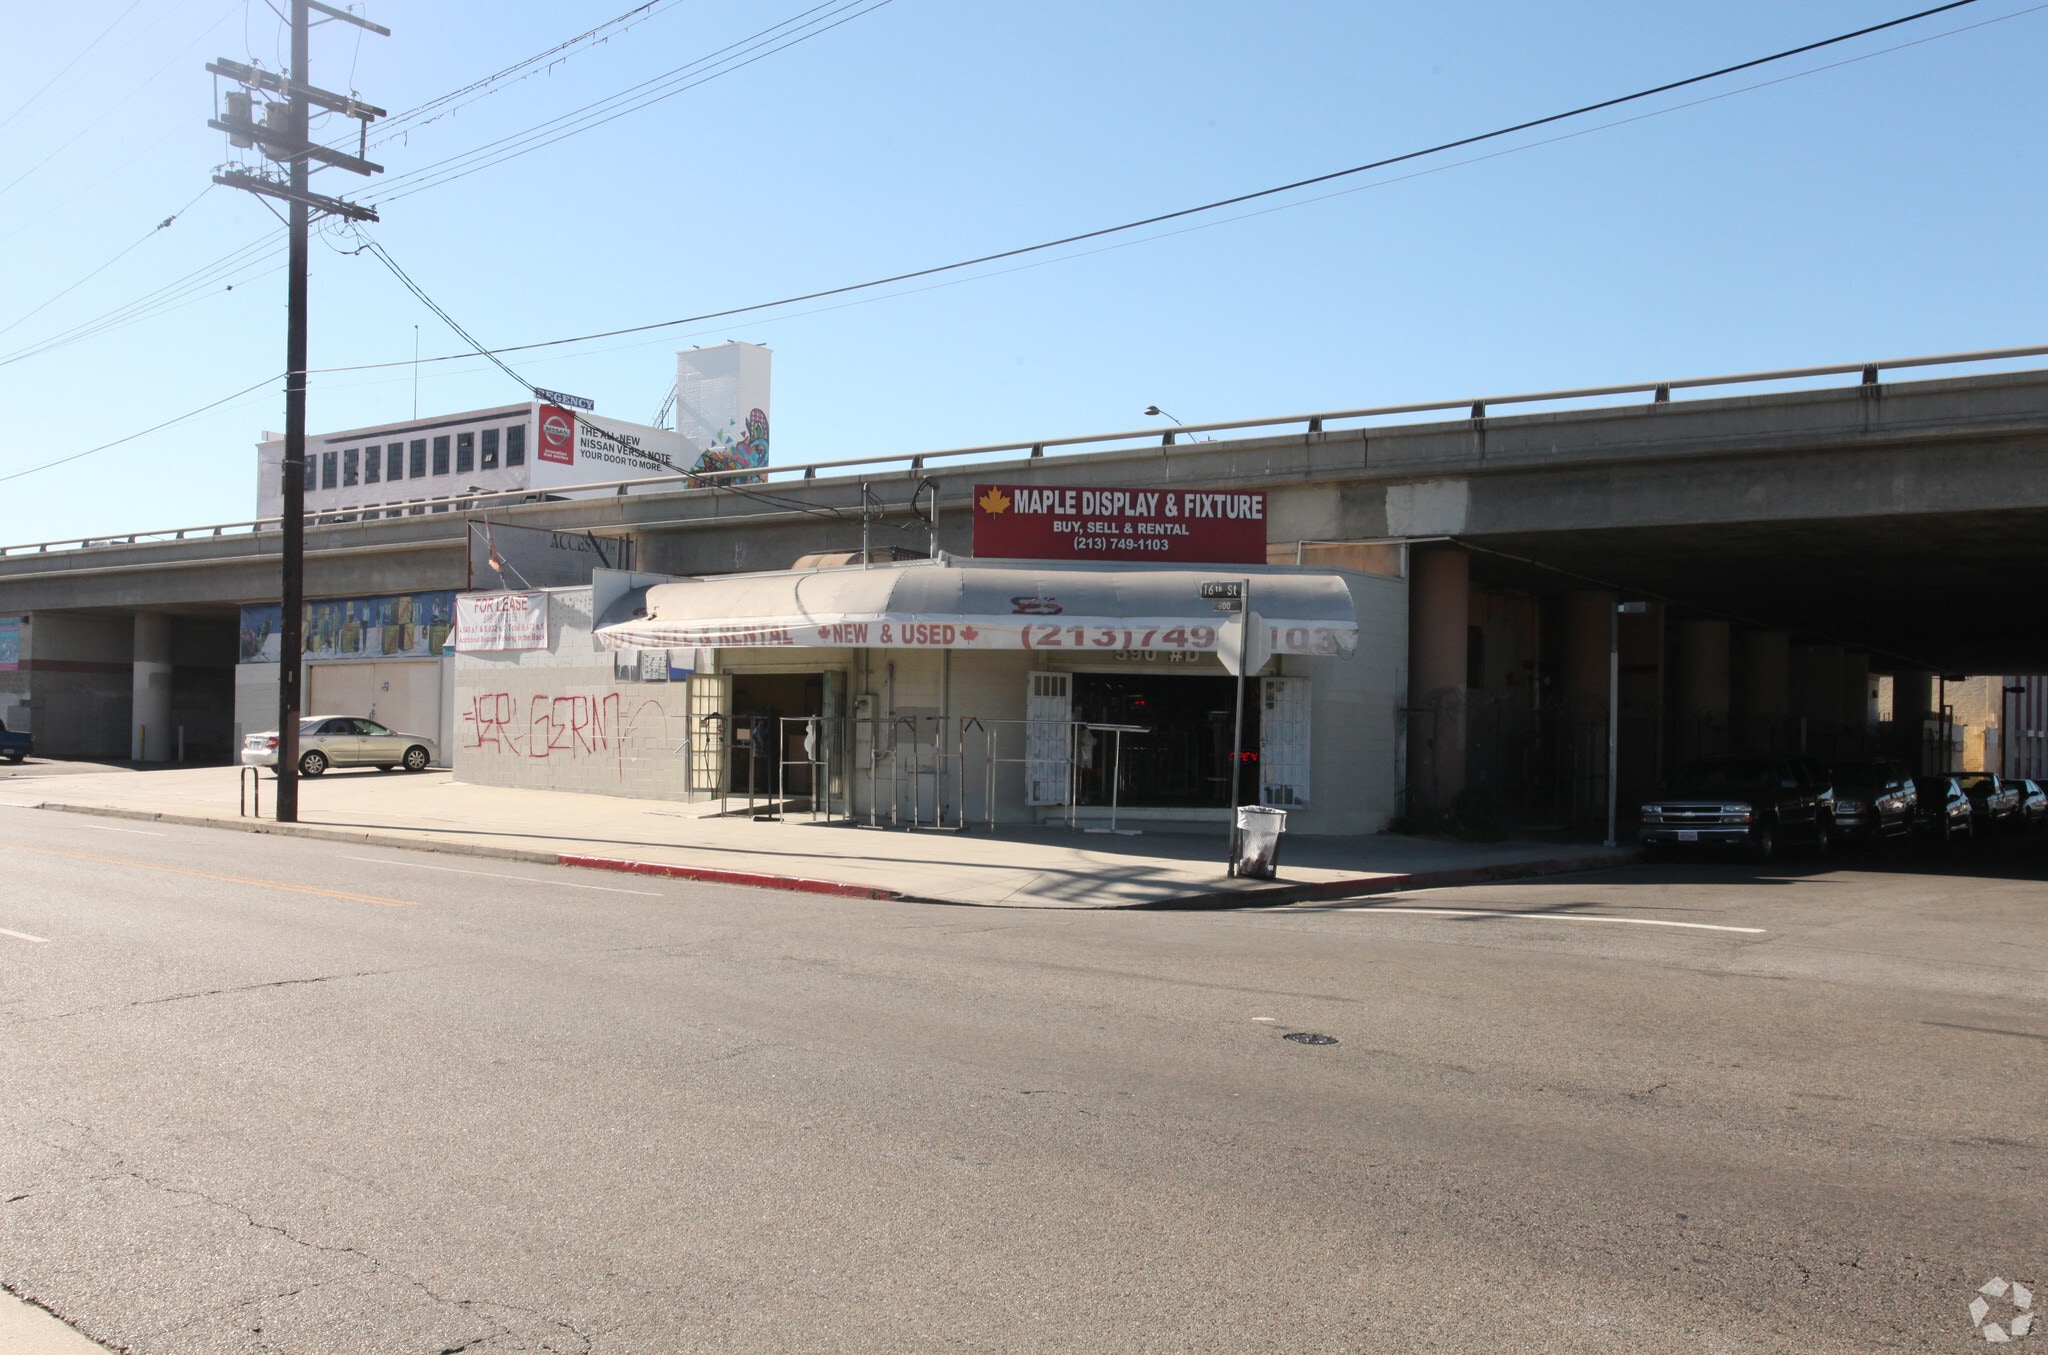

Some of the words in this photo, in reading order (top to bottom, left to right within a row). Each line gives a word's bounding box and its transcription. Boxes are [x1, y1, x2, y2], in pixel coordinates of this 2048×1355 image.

[580, 425, 599, 438] THE
[580, 437, 615, 453] NISSAN
[617, 444, 647, 460] VERSA
[580, 449, 603, 461] YOUR
[603, 453, 627, 466] DOOR
[627, 458, 638, 468] TO
[1014, 489, 1077, 515] MAPLE
[1082, 491, 1160, 517] DISPLAY
[1165, 493, 1179, 518] &
[1184, 493, 1263, 520] FIXTURE
[1053, 521, 1084, 535] BUY,
[1087, 522, 1119, 534] SELL
[1123, 523, 1134, 535] &
[1137, 523, 1190, 536] RENTAL
[1073, 536, 1107, 551] (213)
[1110, 538, 1169, 551] 749-1103
[1204, 584, 1223, 596] 16th
[1227, 584, 1238, 596] St
[475, 597, 494, 614] FOR
[496, 595, 528, 613] LEASE
[718, 625, 794, 646] RENTAL
[833, 623, 869, 644] NEW
[880, 623, 894, 644] &
[902, 623, 956, 645] USED
